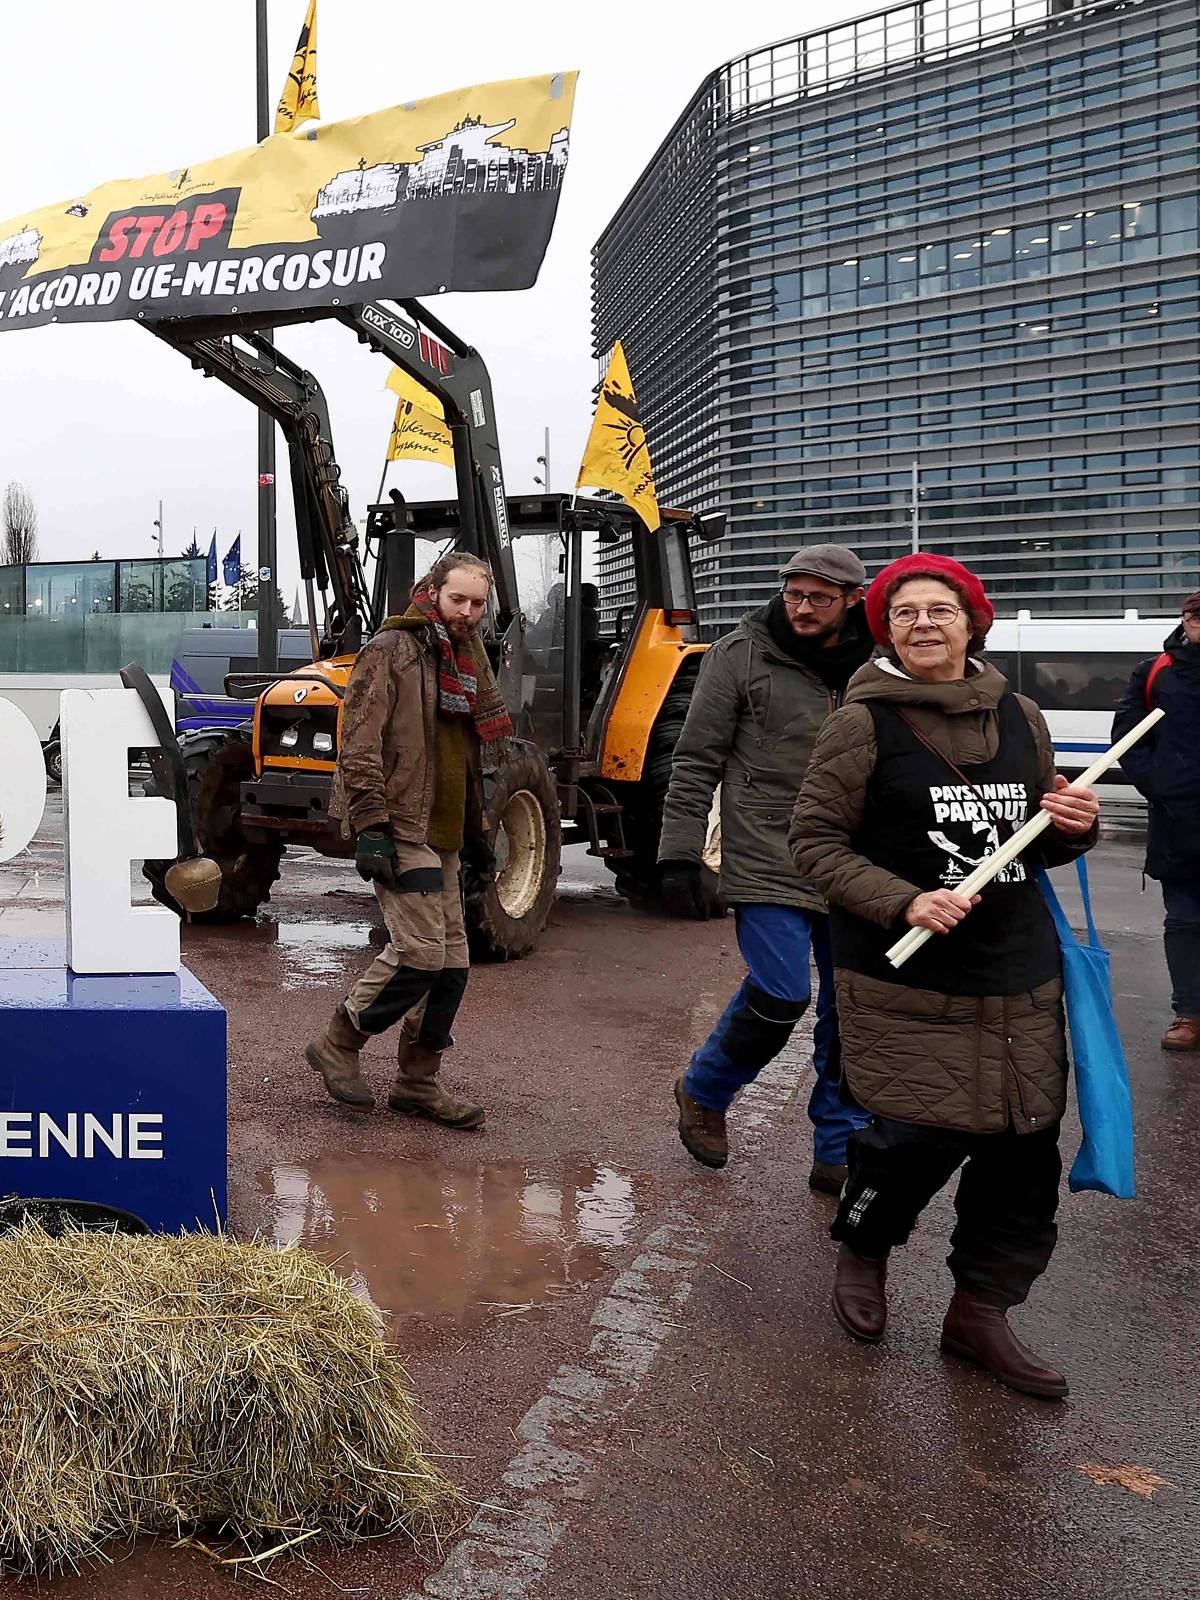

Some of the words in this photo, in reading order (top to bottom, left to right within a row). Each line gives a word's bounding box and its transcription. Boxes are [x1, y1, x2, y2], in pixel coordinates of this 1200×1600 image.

[99, 203, 227, 262] STOP
[128, 242, 386, 300] UE-MERCOSUR
[364, 309, 389, 330] MX
[389, 320, 412, 346] 100
